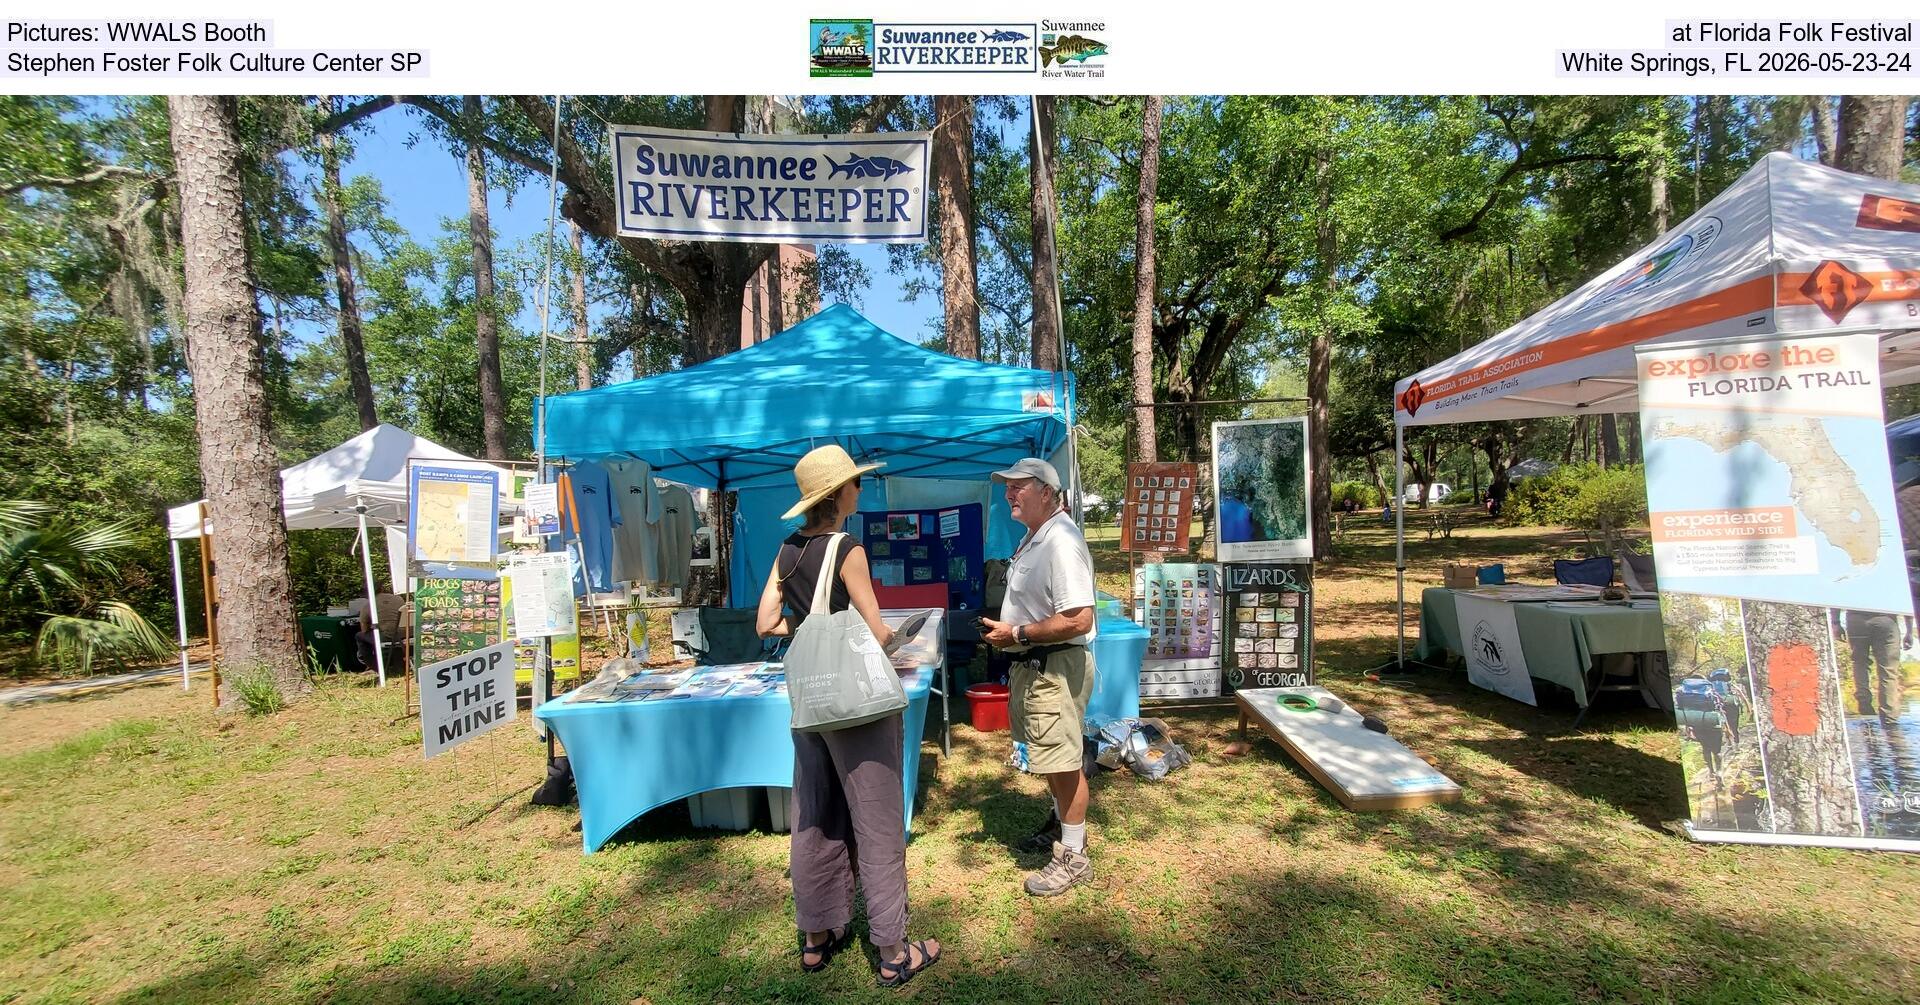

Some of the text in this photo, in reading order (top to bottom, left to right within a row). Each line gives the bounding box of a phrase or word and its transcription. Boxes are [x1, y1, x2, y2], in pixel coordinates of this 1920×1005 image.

[636, 145, 818, 181] Suwannee
[1427, 351, 1544, 397] FLORIDA TRAIL ASSOCIATION
[1648, 345, 1835, 379] explore the
[1434, 378, 1519, 410] Building More Than Trails
[1688, 370, 1871, 398] FLORIDA TRAIL
[1663, 511, 1783, 529] experience
[1664, 525, 1785, 538] FLORIDA'S WILD SIDE
[424, 578, 460, 588] FROGS
[1224, 565, 1296, 592] LIZARDS
[422, 597, 459, 608] TOADS
[436, 651, 502, 689] STOP
[1257, 673, 1307, 687] GEORGIA
[446, 679, 496, 712] THE
[438, 700, 506, 745] MINE
